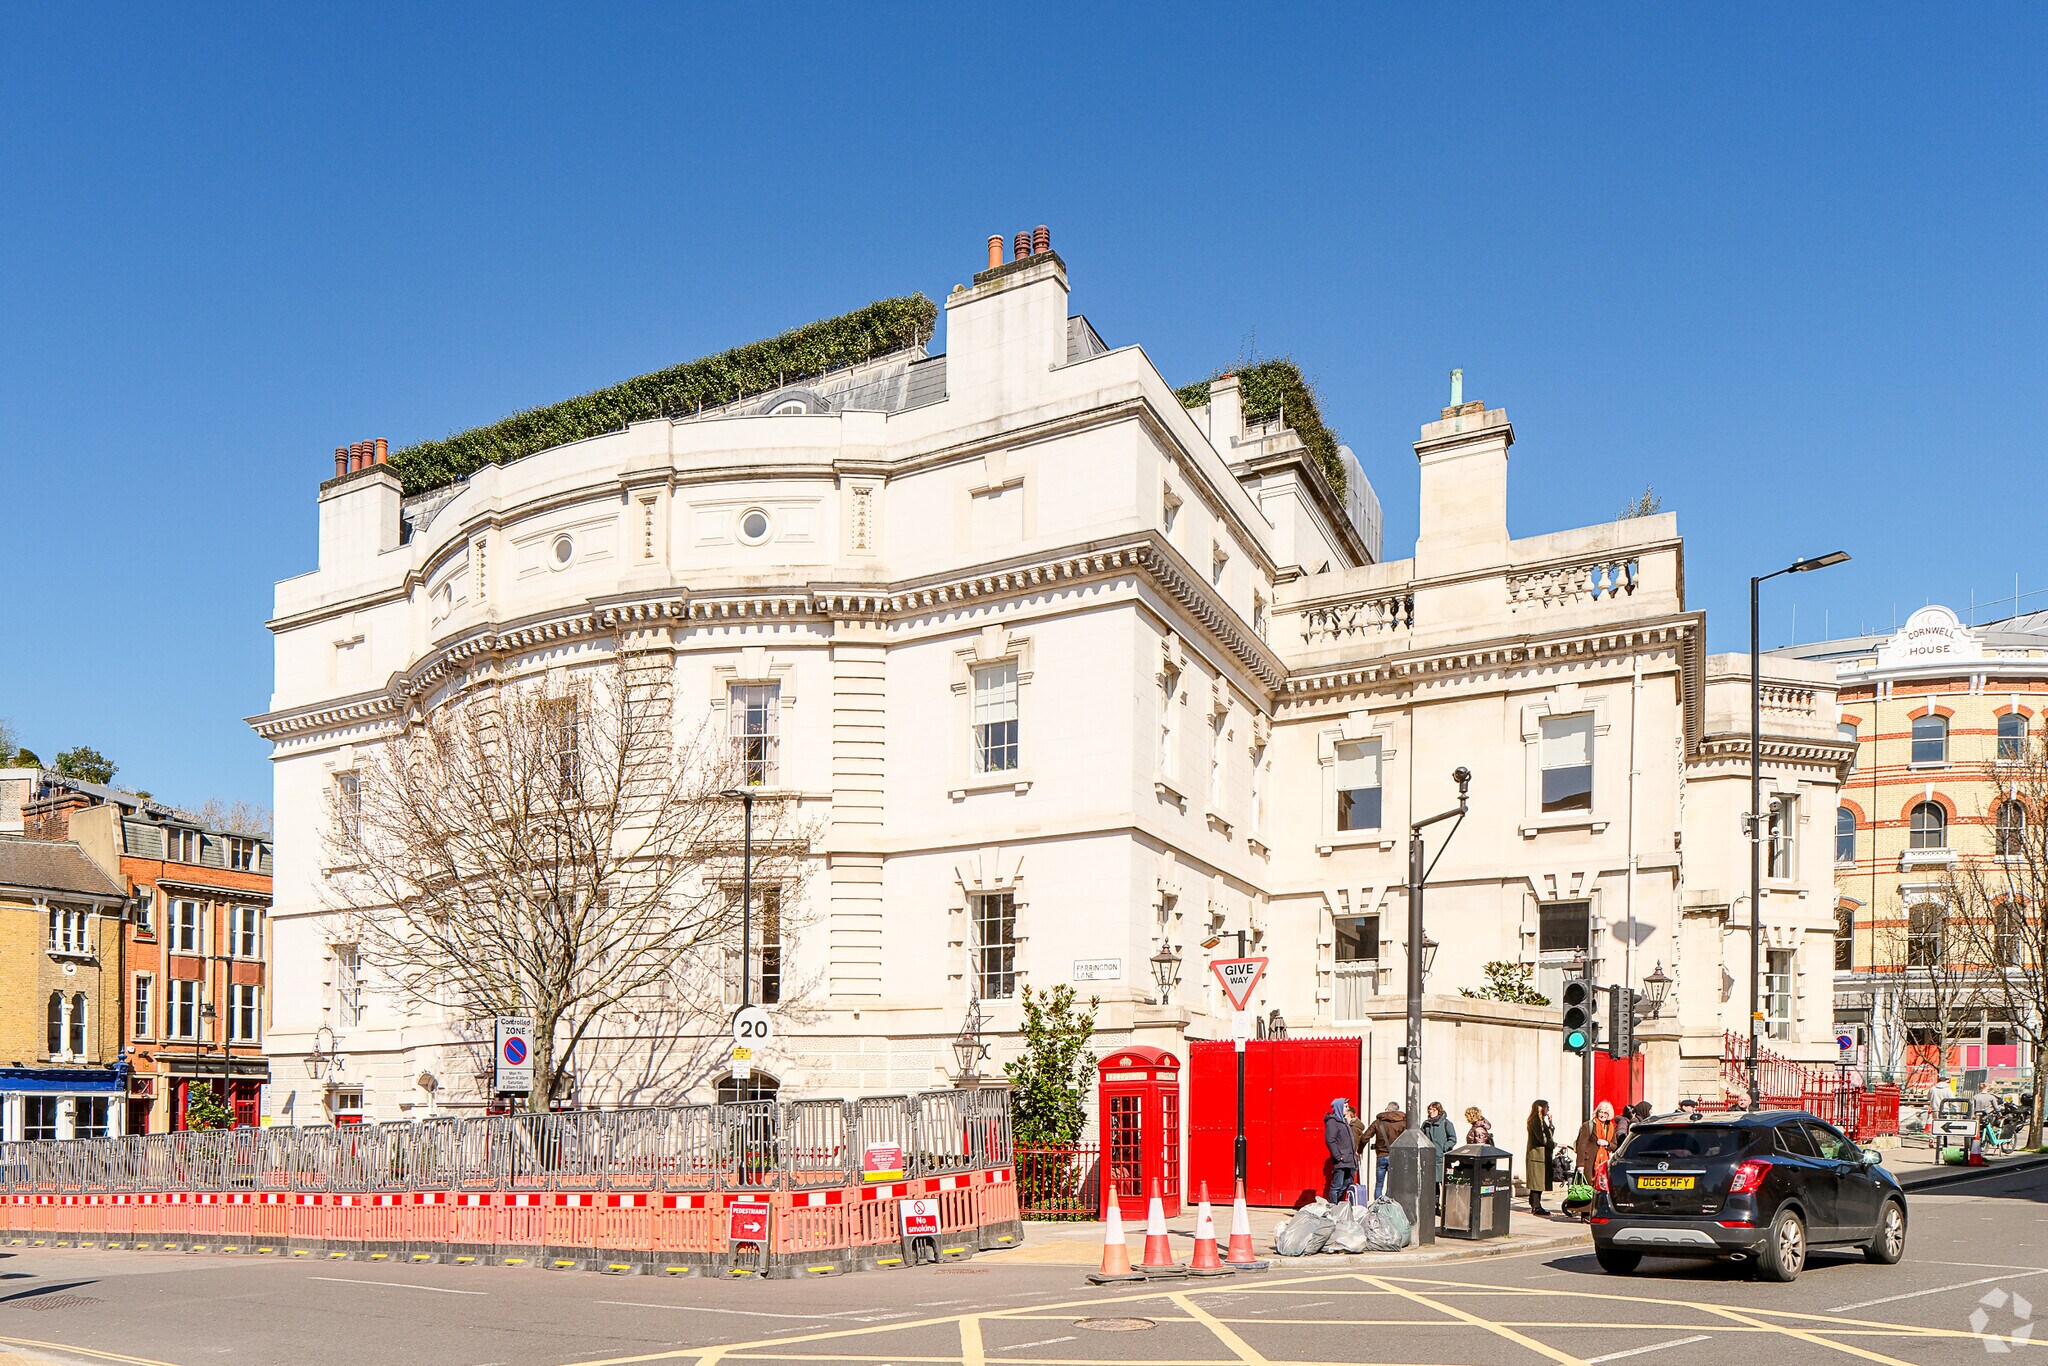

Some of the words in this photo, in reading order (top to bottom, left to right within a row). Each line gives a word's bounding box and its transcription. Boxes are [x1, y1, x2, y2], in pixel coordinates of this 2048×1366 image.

[1908, 627, 1954, 640] CORNWELL
[1909, 645, 1950, 655] HOUSE
[1225, 964, 1253, 976] GIVE
[740, 1020, 768, 1038] 20
[1643, 1177, 1667, 1187] DC66
[1670, 1178, 1689, 1187] MFY
[908, 1224, 936, 1232] smoking
